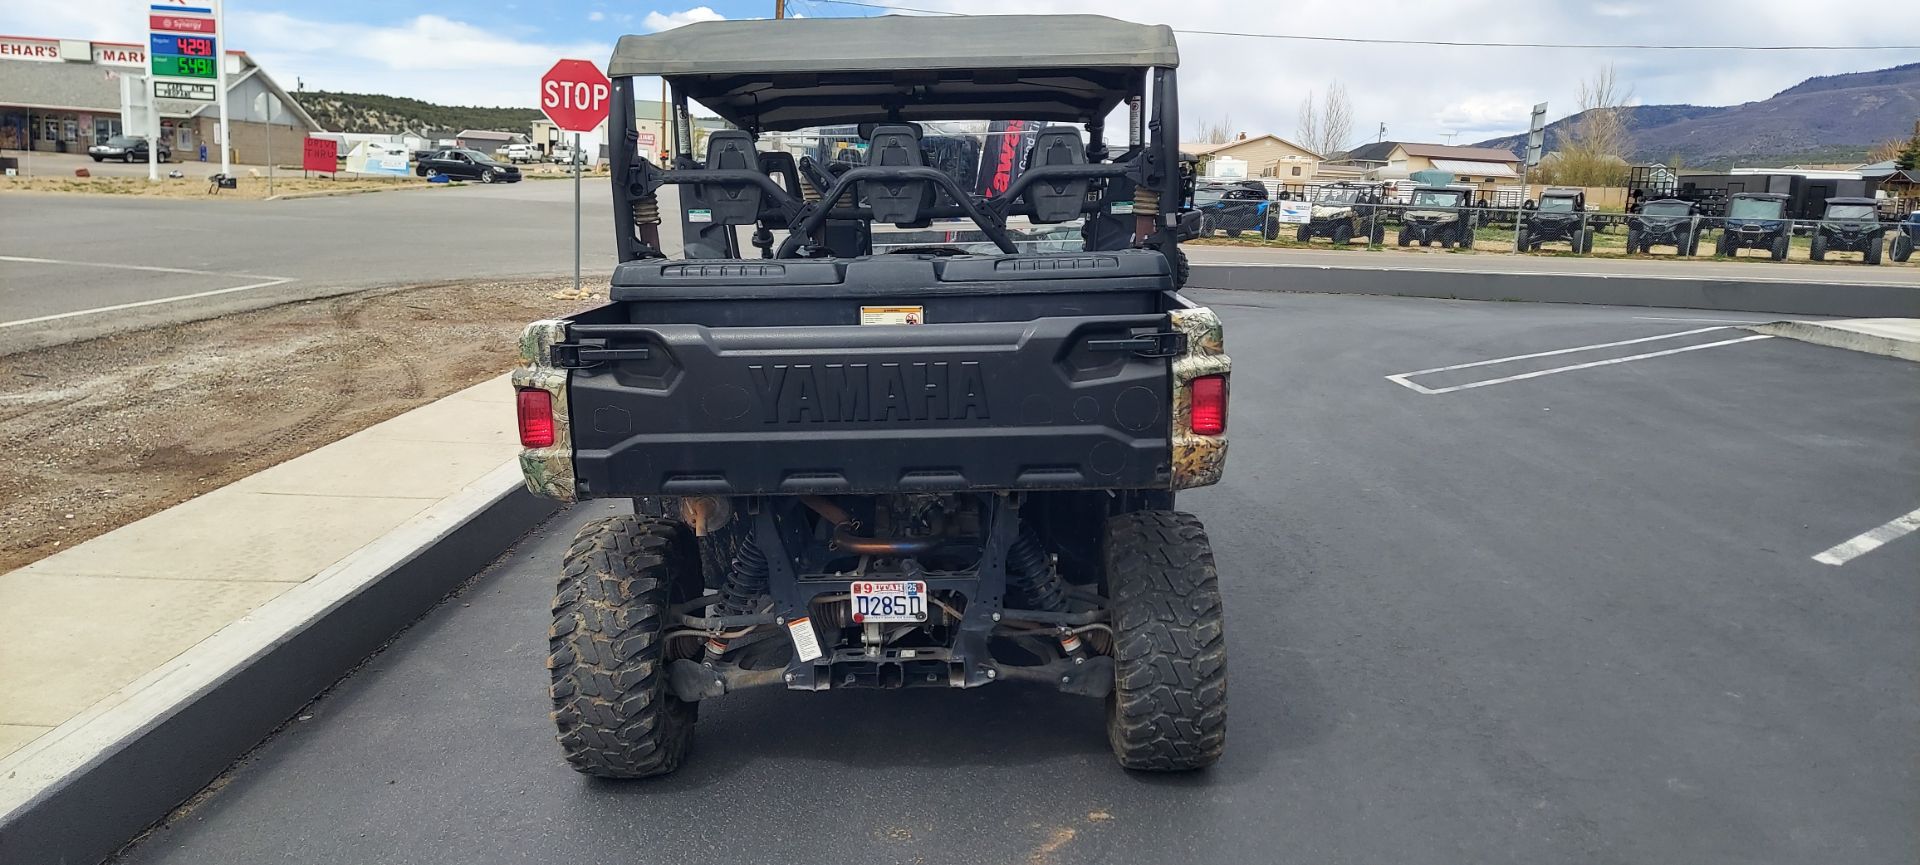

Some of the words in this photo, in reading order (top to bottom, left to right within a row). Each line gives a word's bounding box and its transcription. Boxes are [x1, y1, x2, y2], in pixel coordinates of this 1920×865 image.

[544, 80, 608, 111] STOP
[304, 148, 334, 158] THRU
[748, 361, 991, 424] YAMAHA
[863, 583, 873, 594] 9
[874, 583, 904, 592] UTAH
[908, 583, 917, 593] 25
[856, 596, 921, 615] D285D
